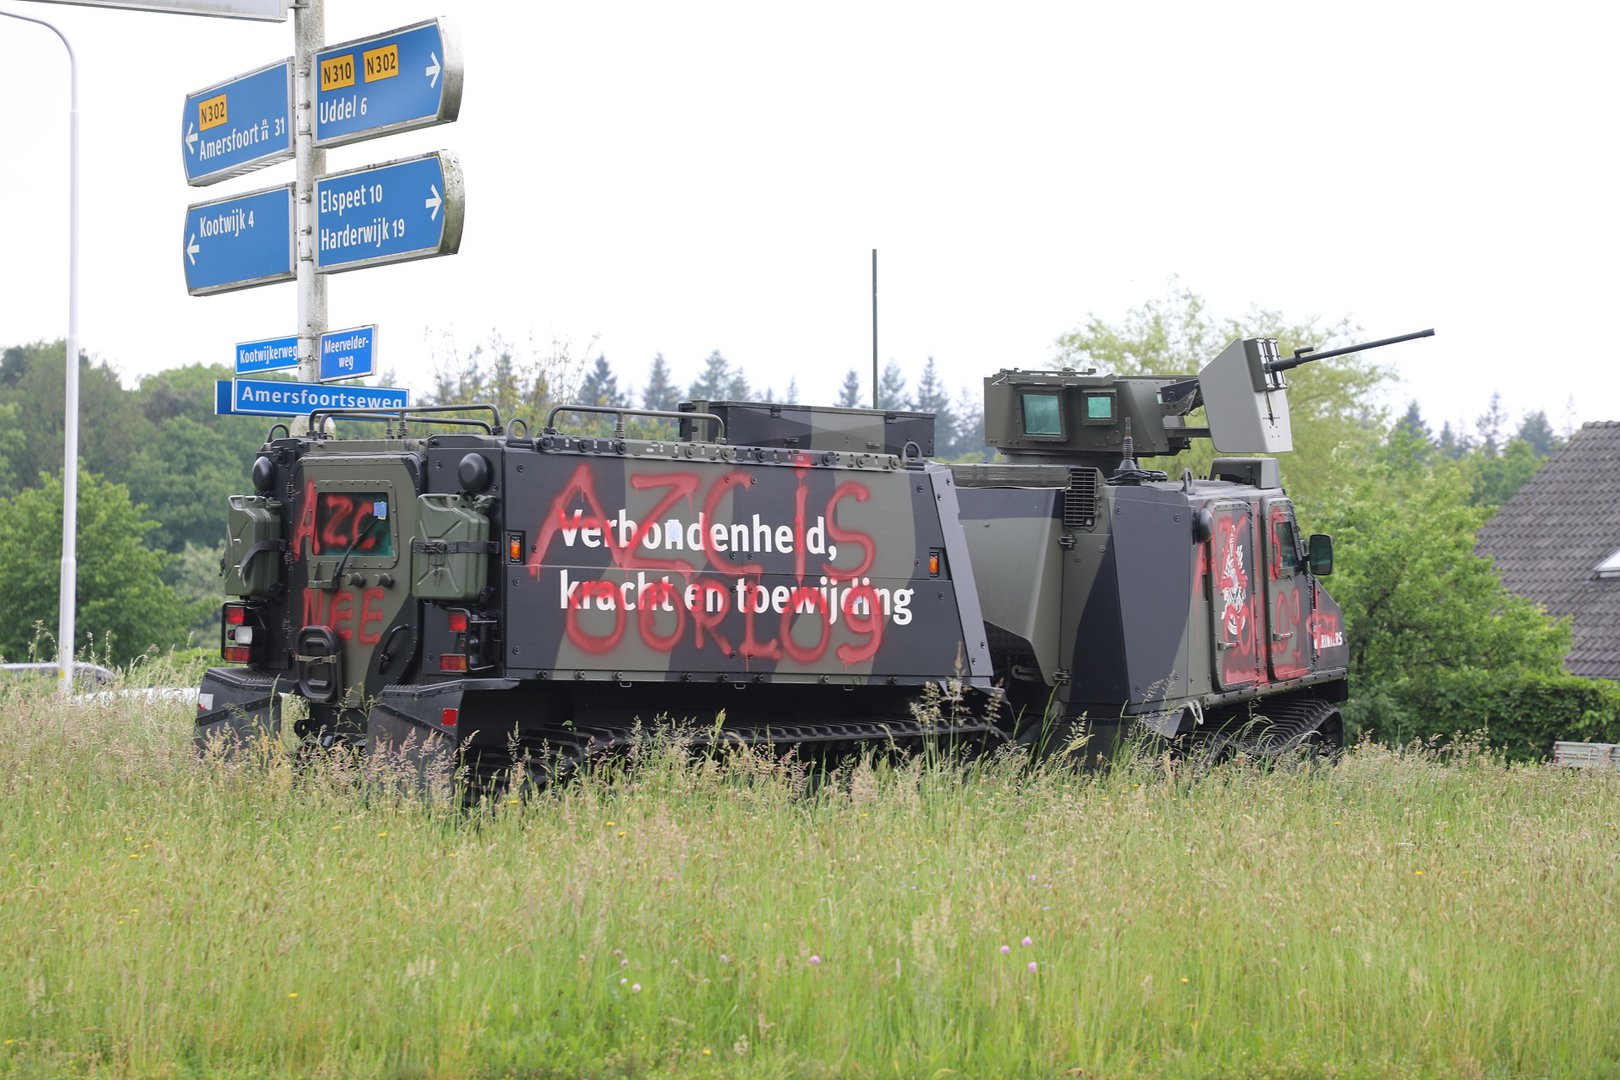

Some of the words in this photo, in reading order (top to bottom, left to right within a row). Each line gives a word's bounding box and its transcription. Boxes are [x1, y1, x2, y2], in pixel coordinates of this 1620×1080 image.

[323, 61, 352, 86] N310
[366, 52, 396, 76] N302
[201, 101, 225, 125] N302
[320, 95, 356, 124] Uddel
[360, 97, 367, 116] 6
[199, 123, 259, 161] Amersfoort
[274, 116, 285, 137] 31
[320, 185, 366, 217] Elspeet
[369, 184, 383, 204] 10
[200, 208, 246, 238] Kootwijk
[248, 210, 255, 228] 4
[321, 219, 389, 251] Harderwijk
[392, 218, 405, 238] 19
[240, 345, 298, 364] Kootwijkerweg
[324, 335, 369, 354] Meervelder-
[338, 355, 354, 370] weg
[241, 386, 403, 409] Amersfoortseweg
[293, 480, 376, 561] AZC
[527, 463, 762, 578] AZC
[557, 508, 837, 561] Verbondenheid,
[560, 569, 674, 612] kracht
[684, 581, 724, 614] en
[735, 575, 914, 626] toewijding
[302, 587, 385, 645] NEE
